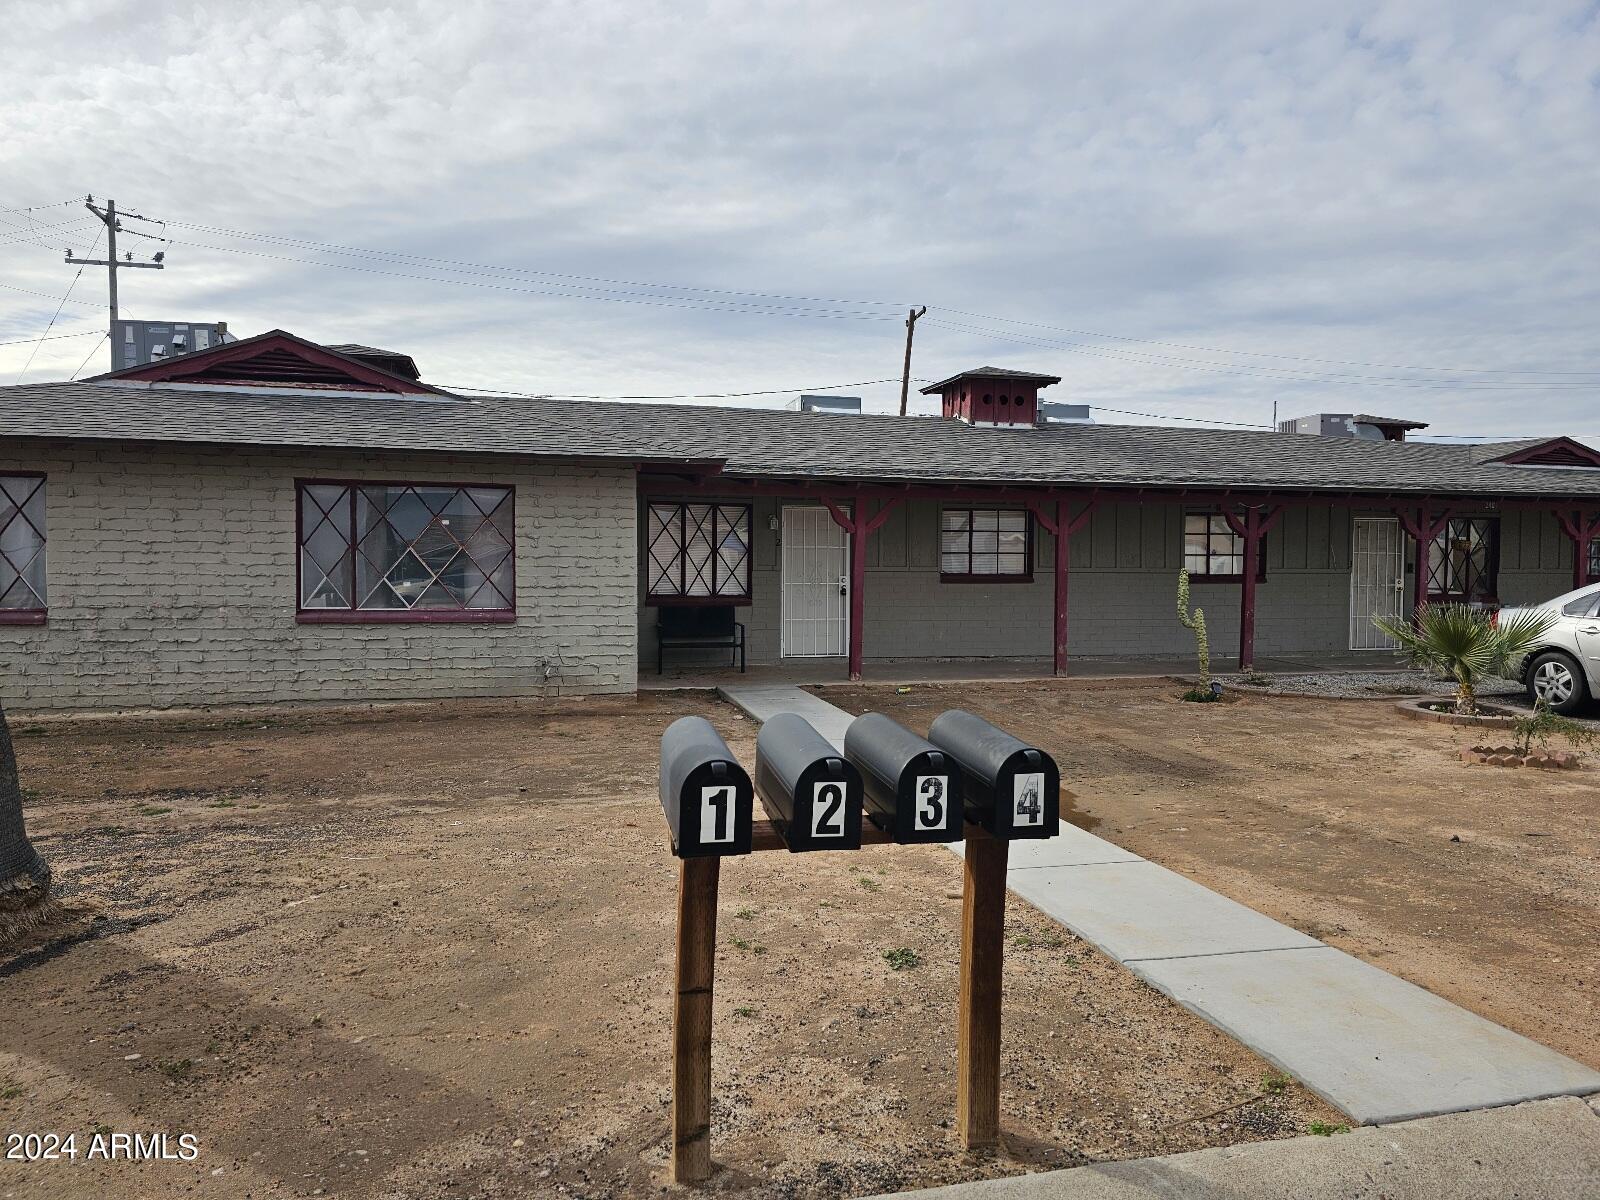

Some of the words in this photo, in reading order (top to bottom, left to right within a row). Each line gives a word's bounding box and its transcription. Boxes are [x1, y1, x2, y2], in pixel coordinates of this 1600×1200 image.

[708, 788, 729, 841] 1
[815, 783, 843, 835] 2
[919, 777, 944, 828] 3
[1016, 778, 1041, 824] 4
